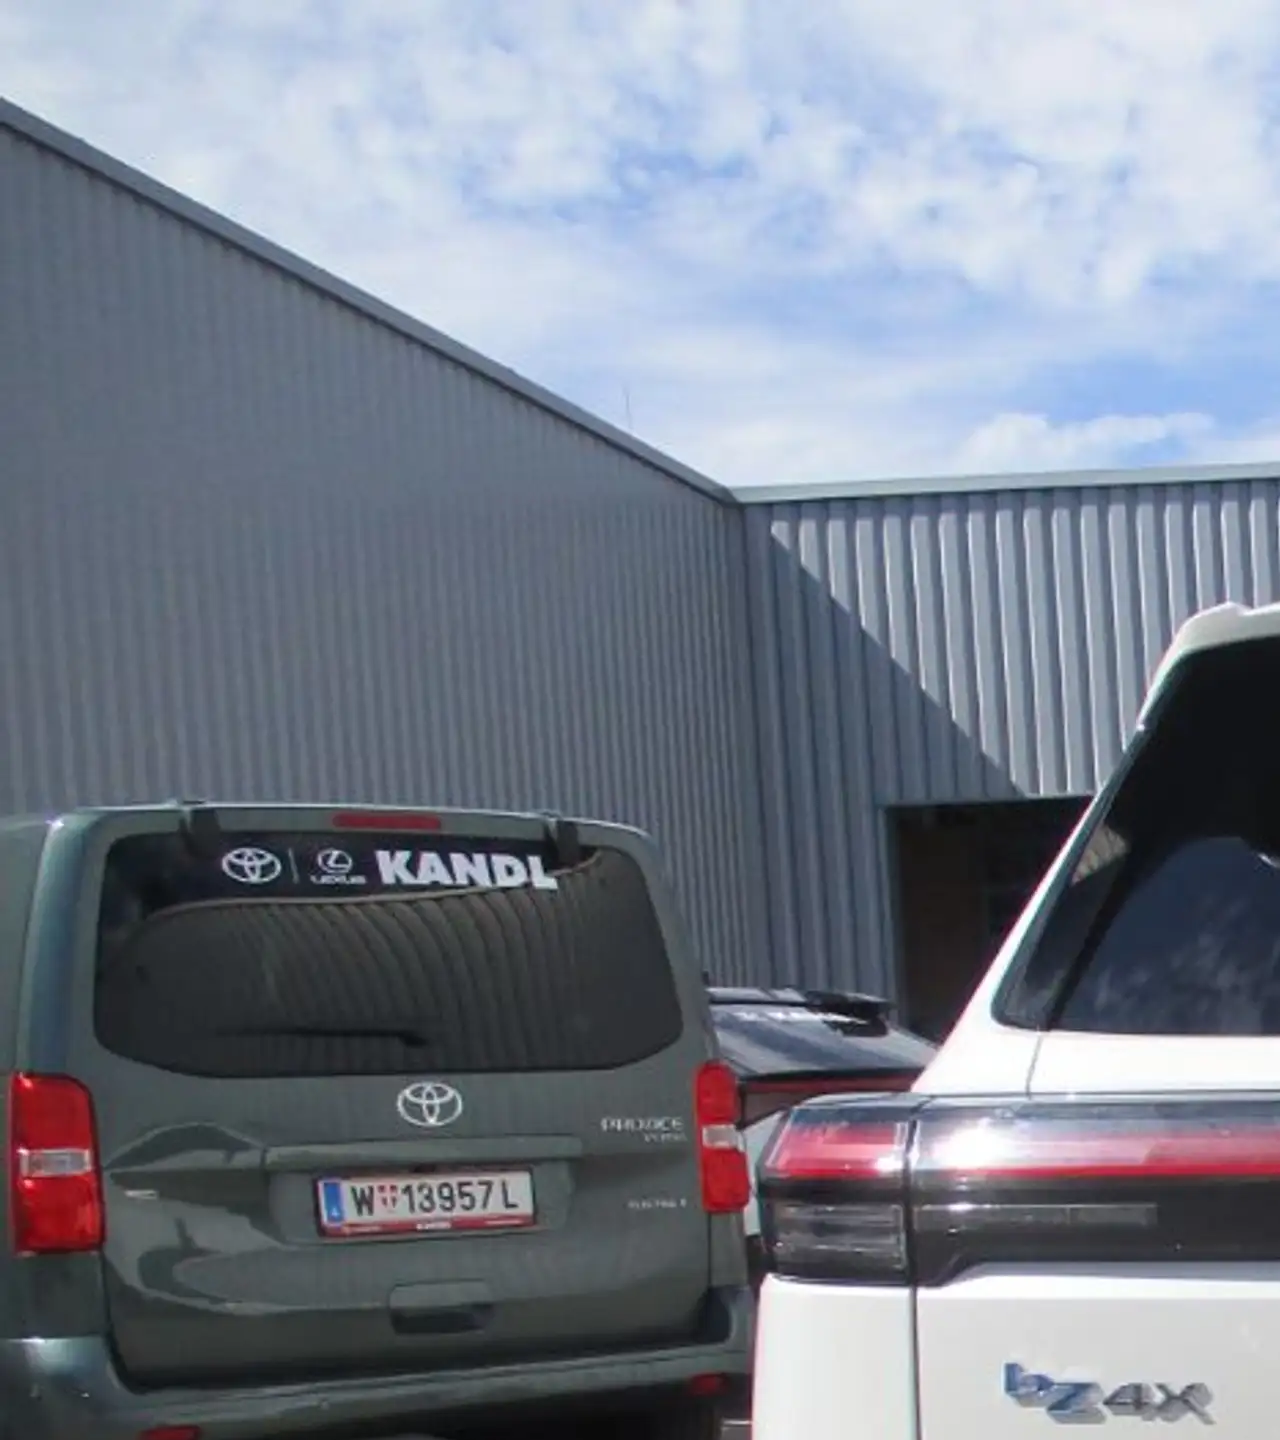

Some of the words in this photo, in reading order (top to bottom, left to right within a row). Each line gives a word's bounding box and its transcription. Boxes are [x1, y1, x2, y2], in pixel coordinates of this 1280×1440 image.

[375, 850, 558, 890] KANDL
[351, 1185, 374, 1216] W
[401, 1181, 493, 1214] 13957
[502, 1181, 519, 1209] L
